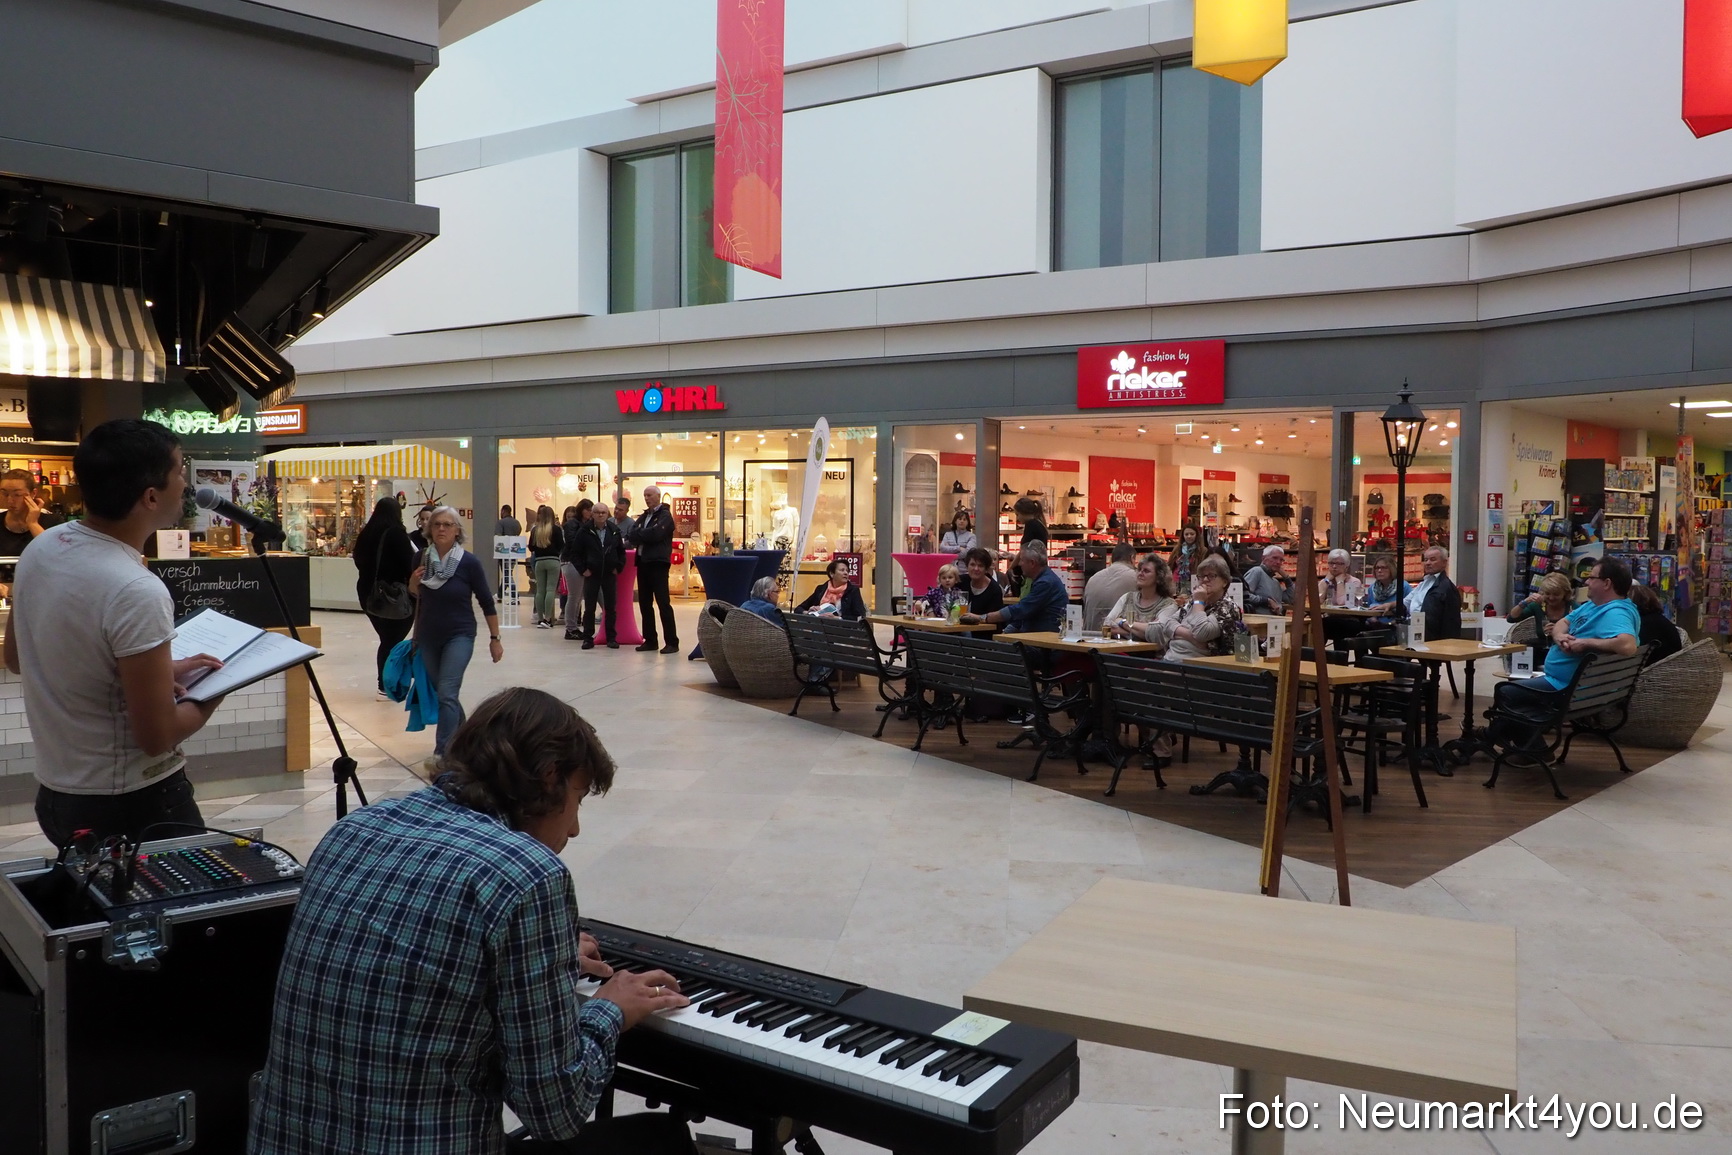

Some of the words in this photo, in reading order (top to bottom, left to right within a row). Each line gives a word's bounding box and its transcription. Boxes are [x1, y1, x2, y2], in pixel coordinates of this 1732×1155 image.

[1143, 350, 1175, 363] fashion
[1178, 349, 1190, 365] by
[616, 382, 726, 413] WÖHRL
[1516, 442, 1553, 462] Spielwaren
[825, 471, 846, 480] NEU
[1538, 464, 1557, 478] Krömer
[577, 474, 593, 483] NEU
[1109, 489, 1137, 502] rieker
